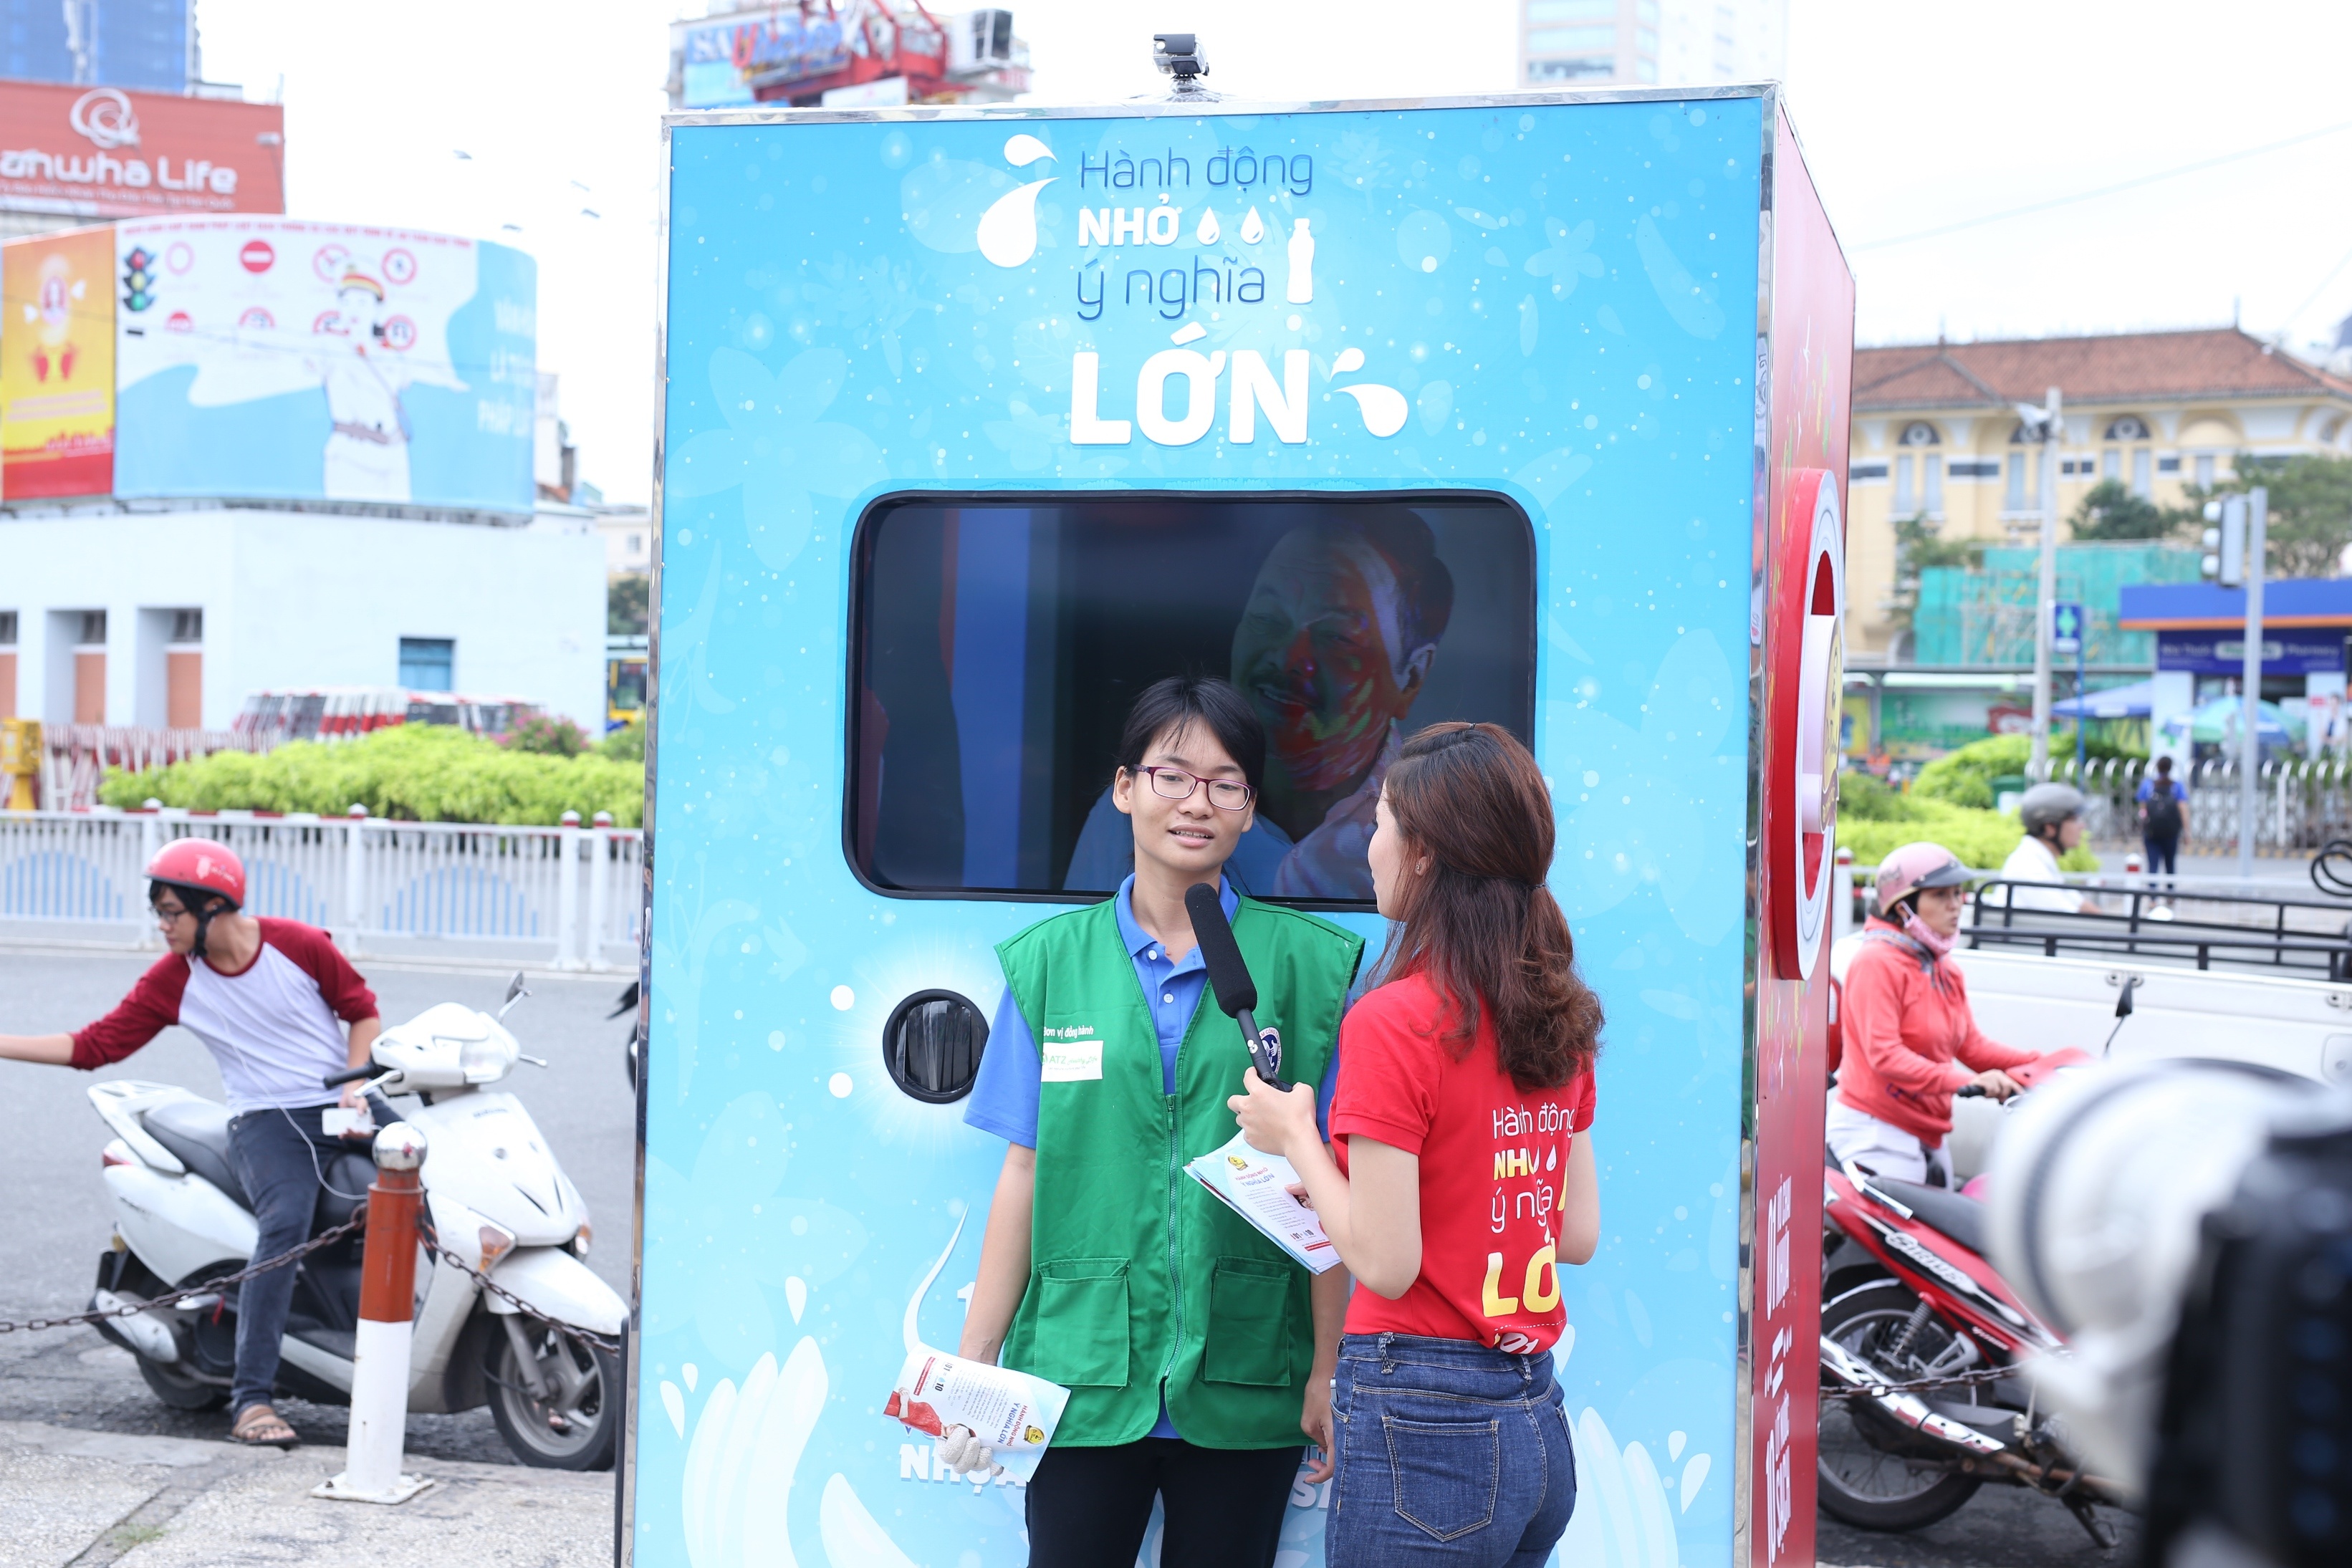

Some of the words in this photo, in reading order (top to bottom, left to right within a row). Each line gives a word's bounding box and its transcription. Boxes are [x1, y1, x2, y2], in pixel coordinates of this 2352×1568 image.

[1080, 145, 1190, 189] Hành
[1206, 144, 1314, 196] động
[1077, 193, 1181, 247] NHỎ
[1077, 258, 1105, 321] ý
[1125, 254, 1265, 319] nghĩa
[1070, 322, 1310, 446] LỚN
[1057, 1026, 1064, 1039] vị
[1065, 1024, 1077, 1039] đồng
[1077, 1024, 1094, 1036] hành
[1049, 1056, 1066, 1064] ATZ
[1490, 1185, 1506, 1233] ý
[934, 1382, 944, 1393] 10
[1004, 1408, 1019, 1429] NGHĨA
[1017, 1405, 1028, 1423] HÀNH
[997, 1428, 1009, 1445] LỚN
[1012, 1420, 1022, 1438] ĐỘNG
[1007, 1435, 1016, 1448] NHỎ
